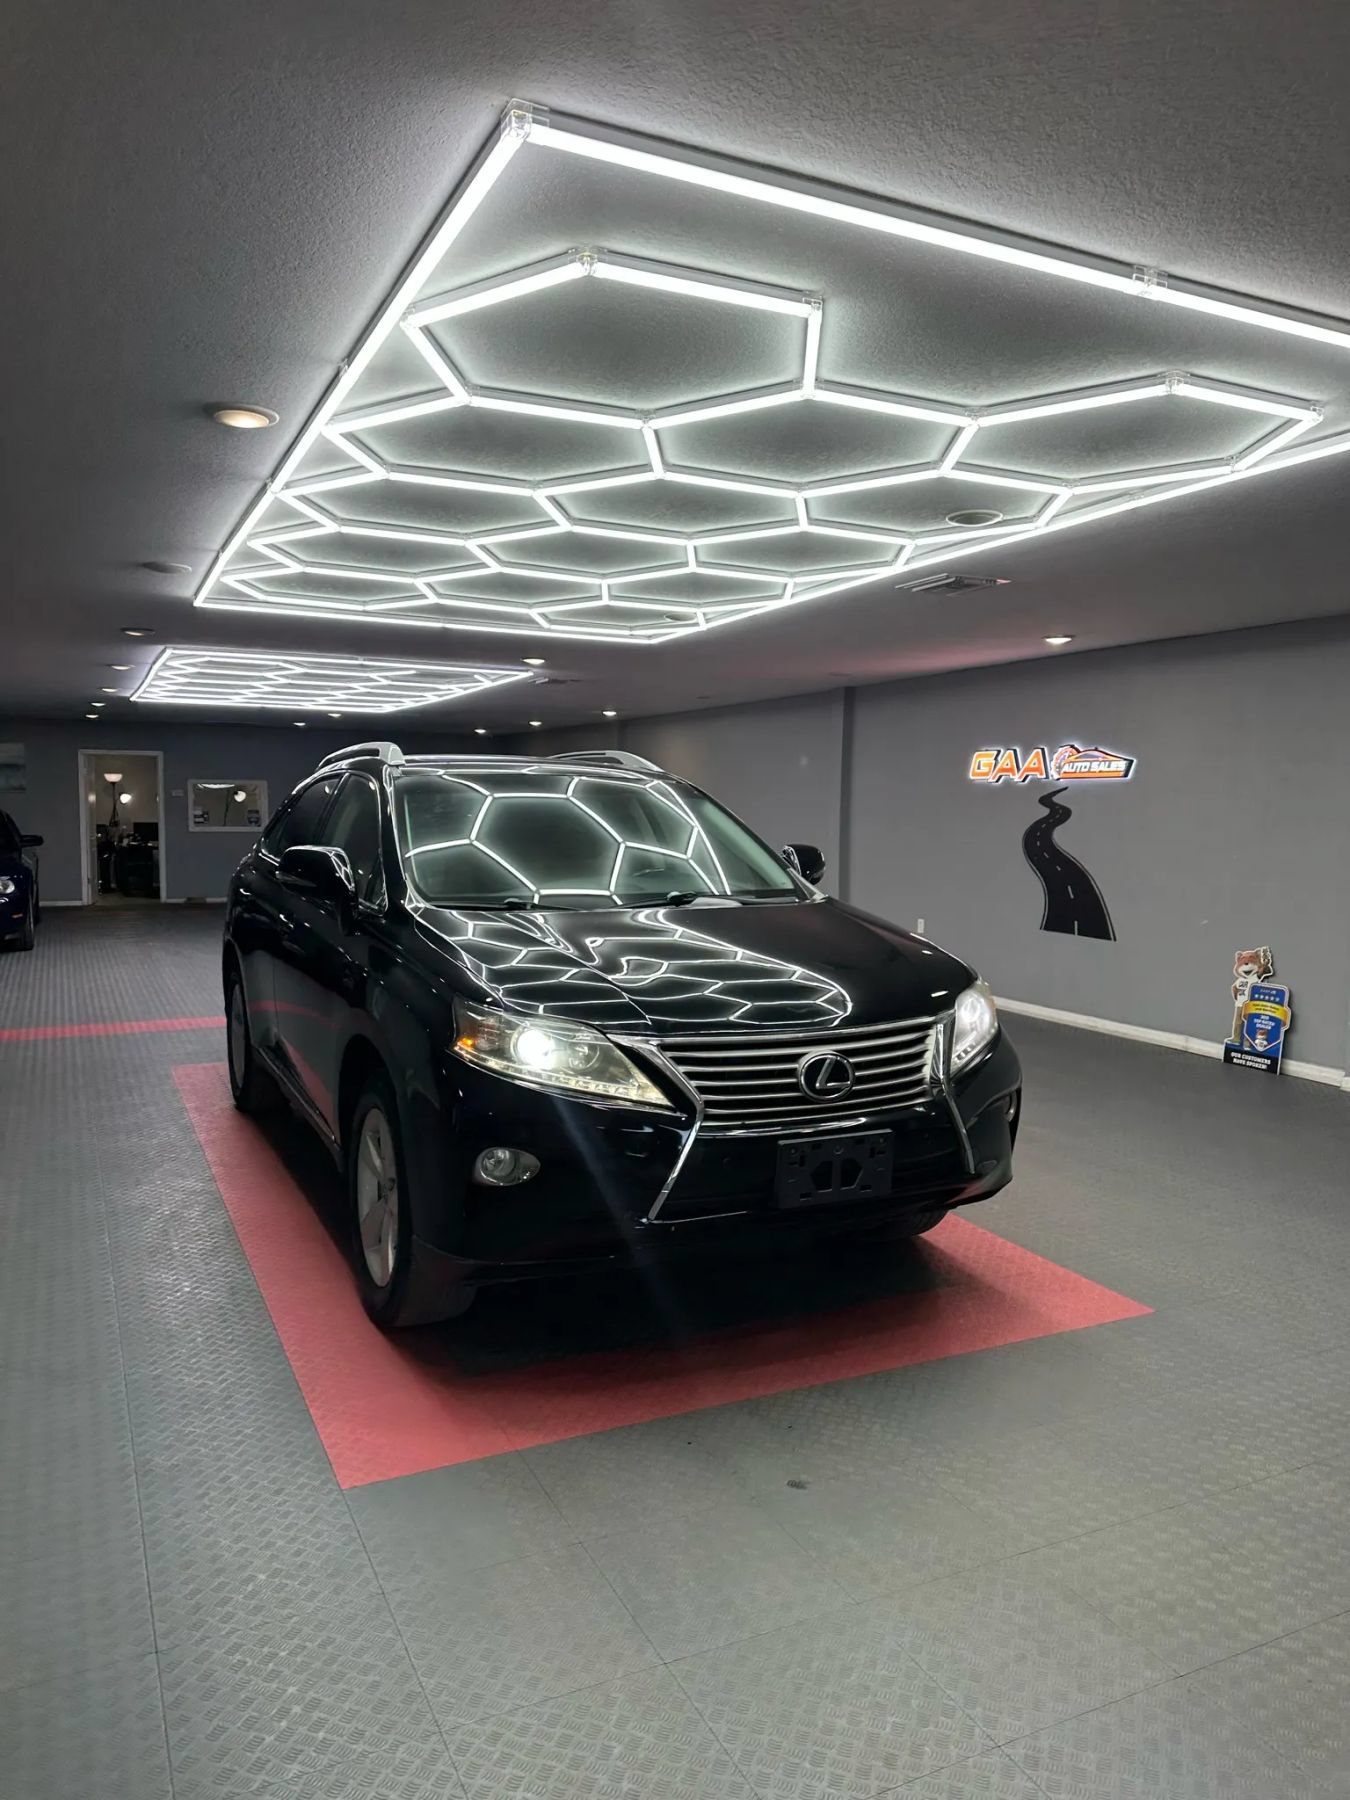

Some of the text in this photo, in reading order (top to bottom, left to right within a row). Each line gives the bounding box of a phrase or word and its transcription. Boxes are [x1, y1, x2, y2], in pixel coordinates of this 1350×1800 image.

[970, 748, 1048, 783] GAA
[1062, 760, 1127, 772] AUTO SALES
[1242, 1054, 1271, 1065] CUSTOMERS
